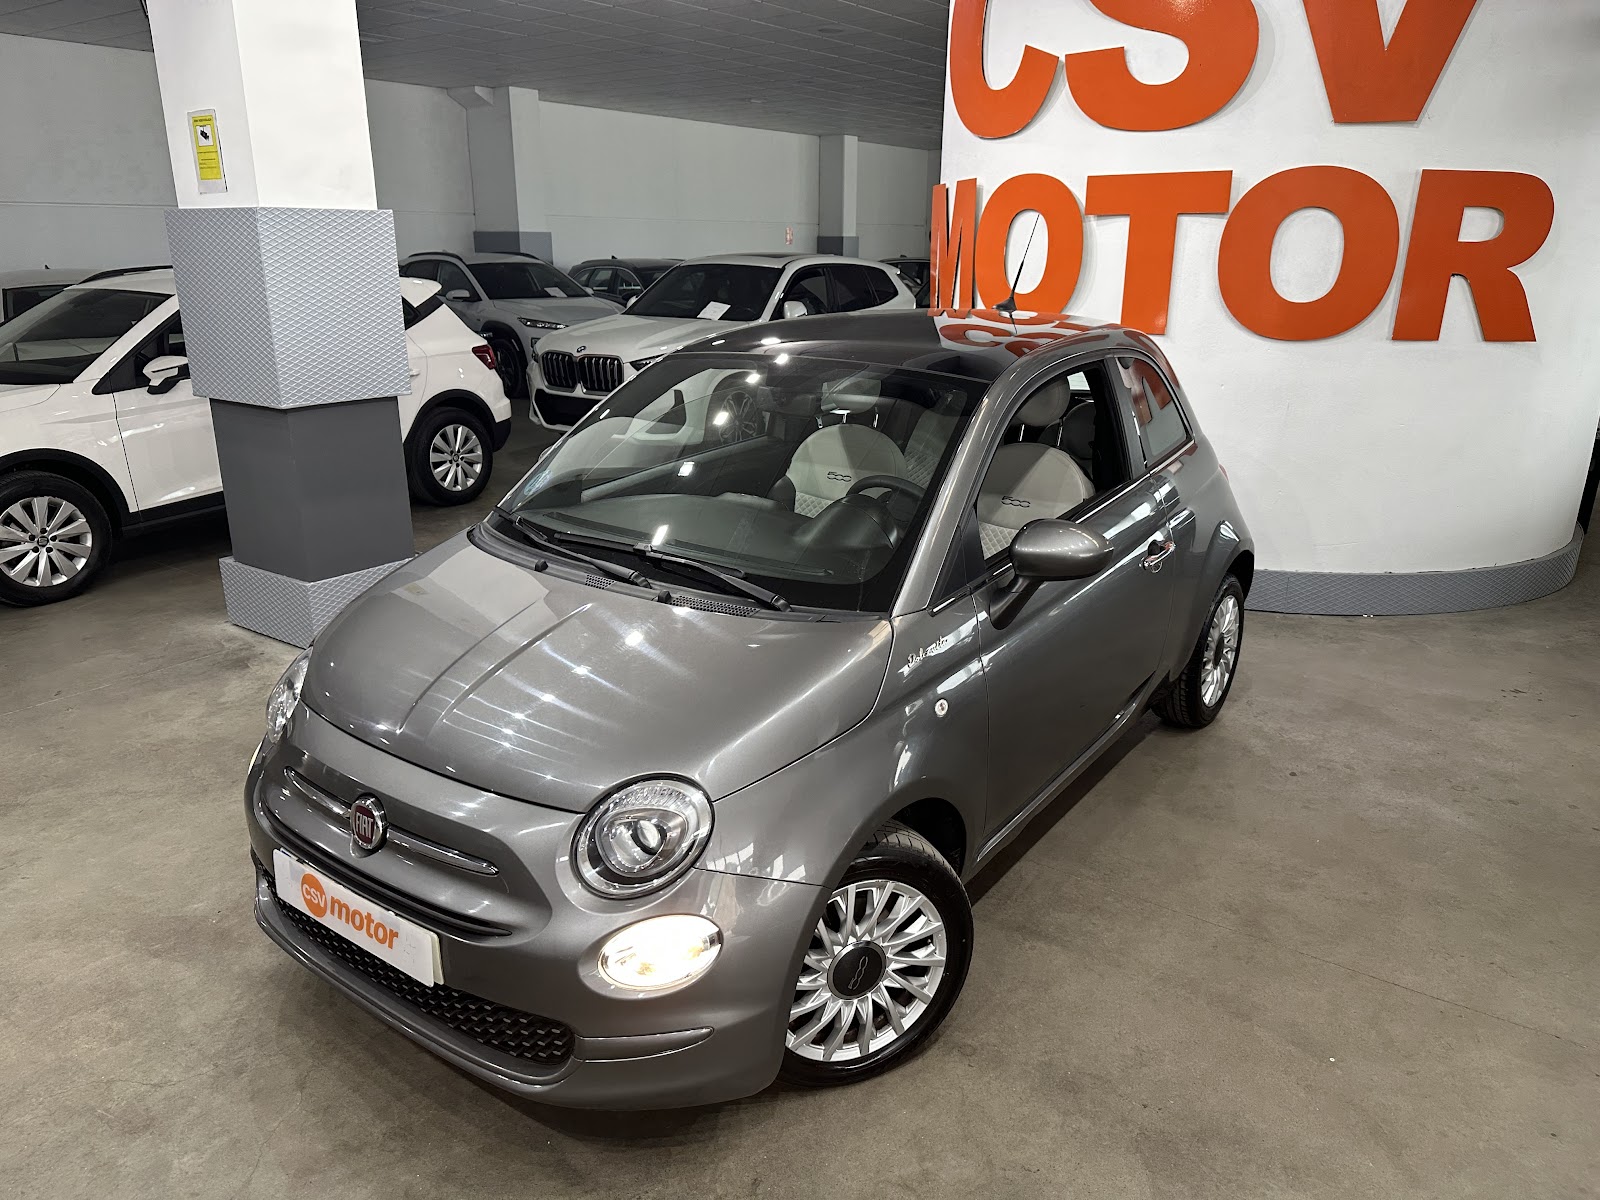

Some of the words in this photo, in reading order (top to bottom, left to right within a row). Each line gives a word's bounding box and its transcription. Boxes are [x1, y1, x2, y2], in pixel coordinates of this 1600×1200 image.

[949, 0, 1477, 139] CSV
[930, 165, 1555, 342] MOTOR
[355, 811, 374, 839] FIAT
[302, 883, 326, 908] CSV
[329, 895, 399, 950] motor
